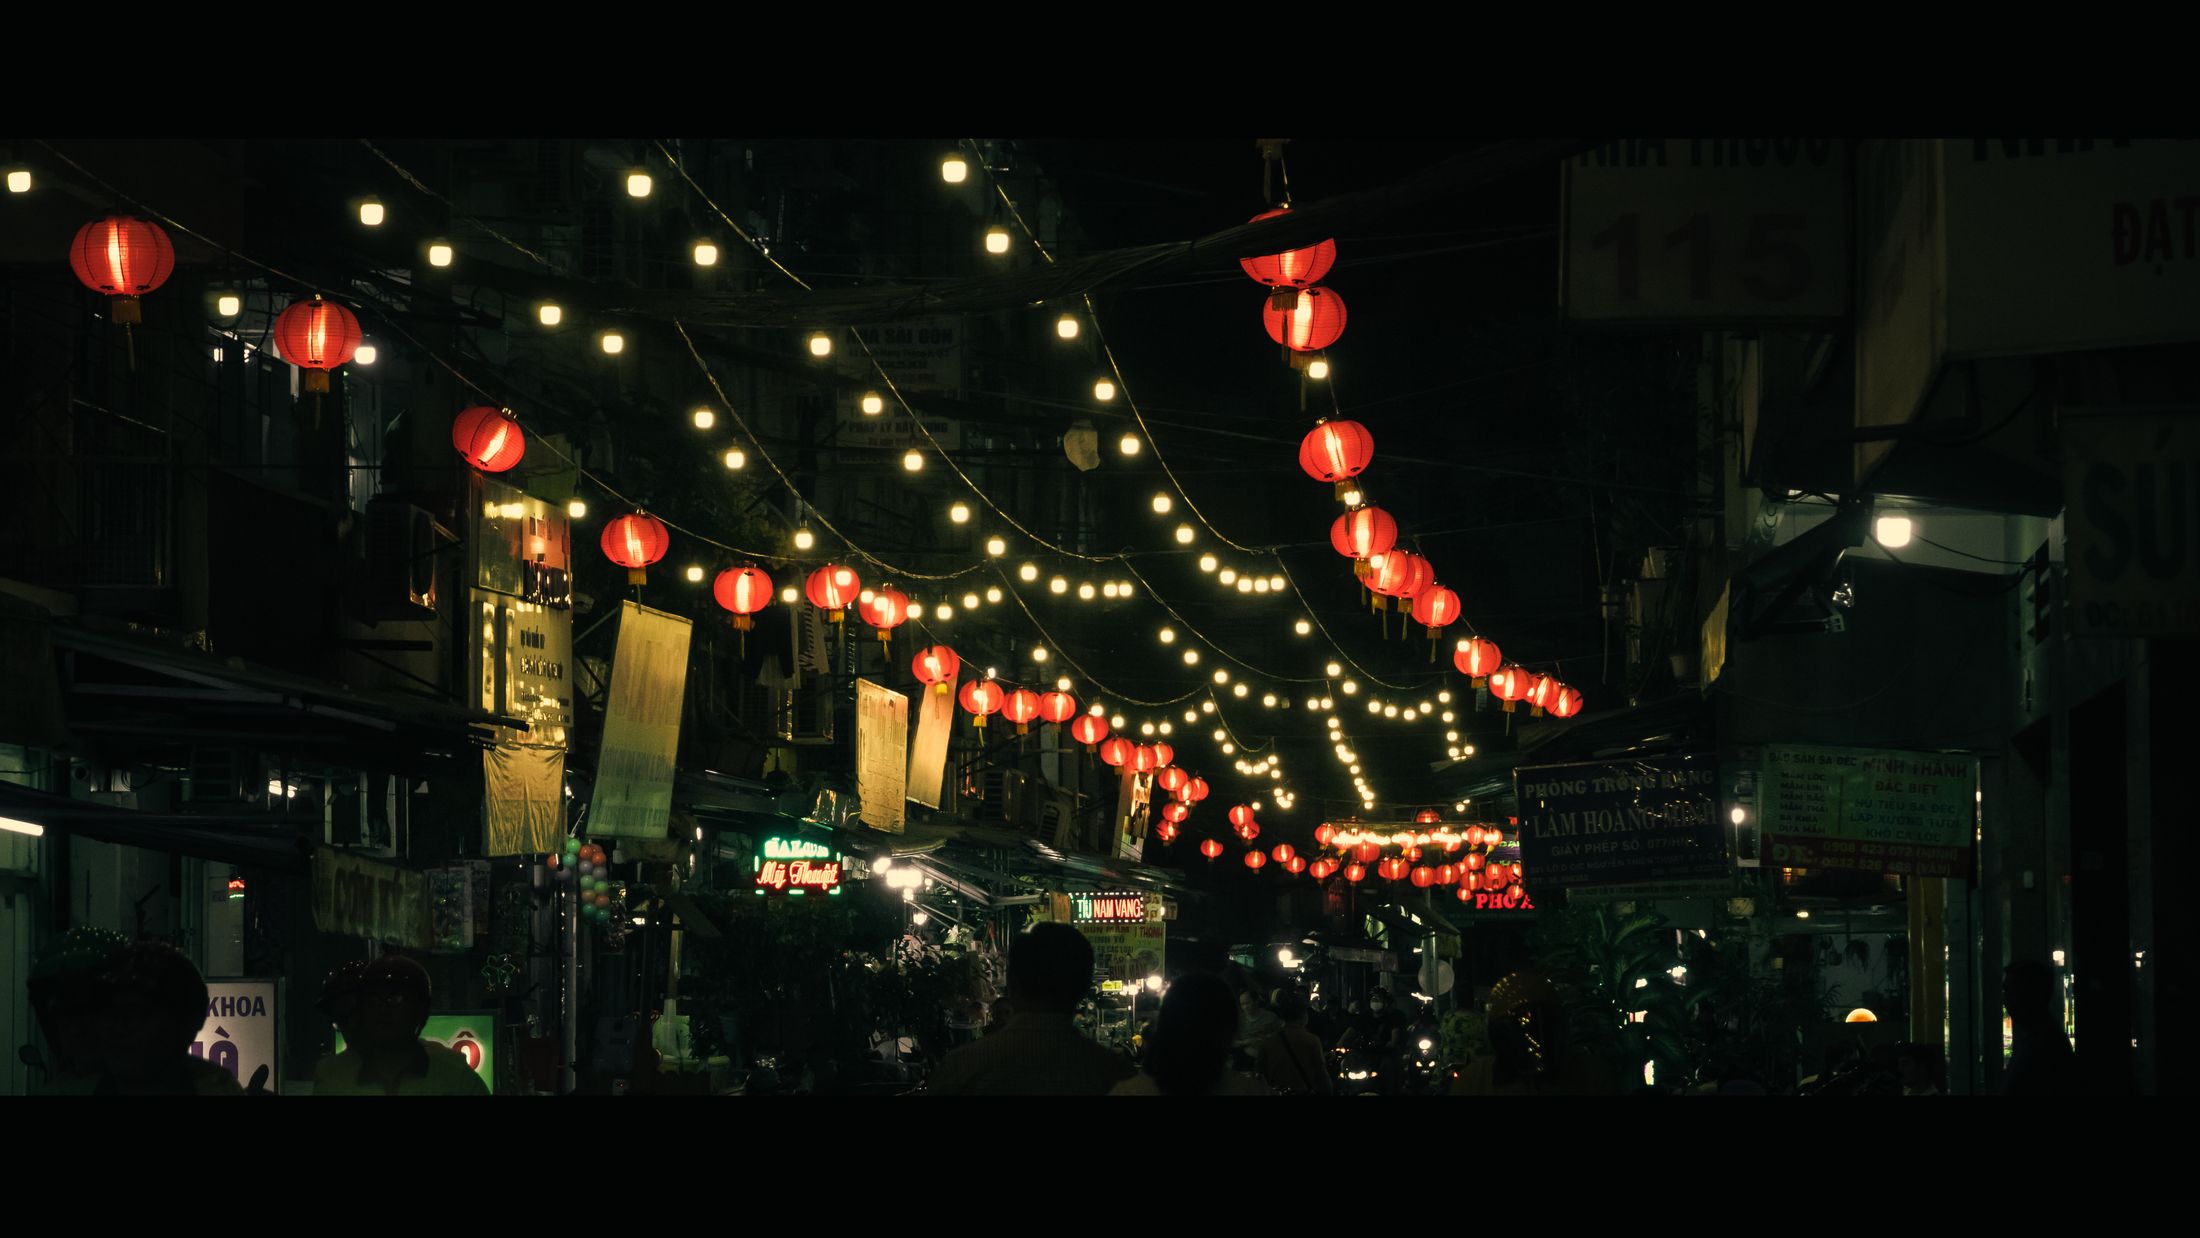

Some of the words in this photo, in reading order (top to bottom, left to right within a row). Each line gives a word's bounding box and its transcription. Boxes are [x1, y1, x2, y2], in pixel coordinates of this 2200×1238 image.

[1591, 213, 1812, 302] 115
[2082, 424, 2200, 581] SÚ
[1818, 754, 1833, 766] SA
[1524, 778, 1587, 799] PHÒNG
[1532, 807, 1577, 839] LÂM
[1583, 801, 1657, 835] HOÀNG
[756, 861, 786, 889] Mỹ
[790, 861, 839, 890] Thuật
[1093, 898, 1114, 919] NAM
[1115, 897, 1142, 919] VANG
[207, 996, 266, 1017] KHOA
